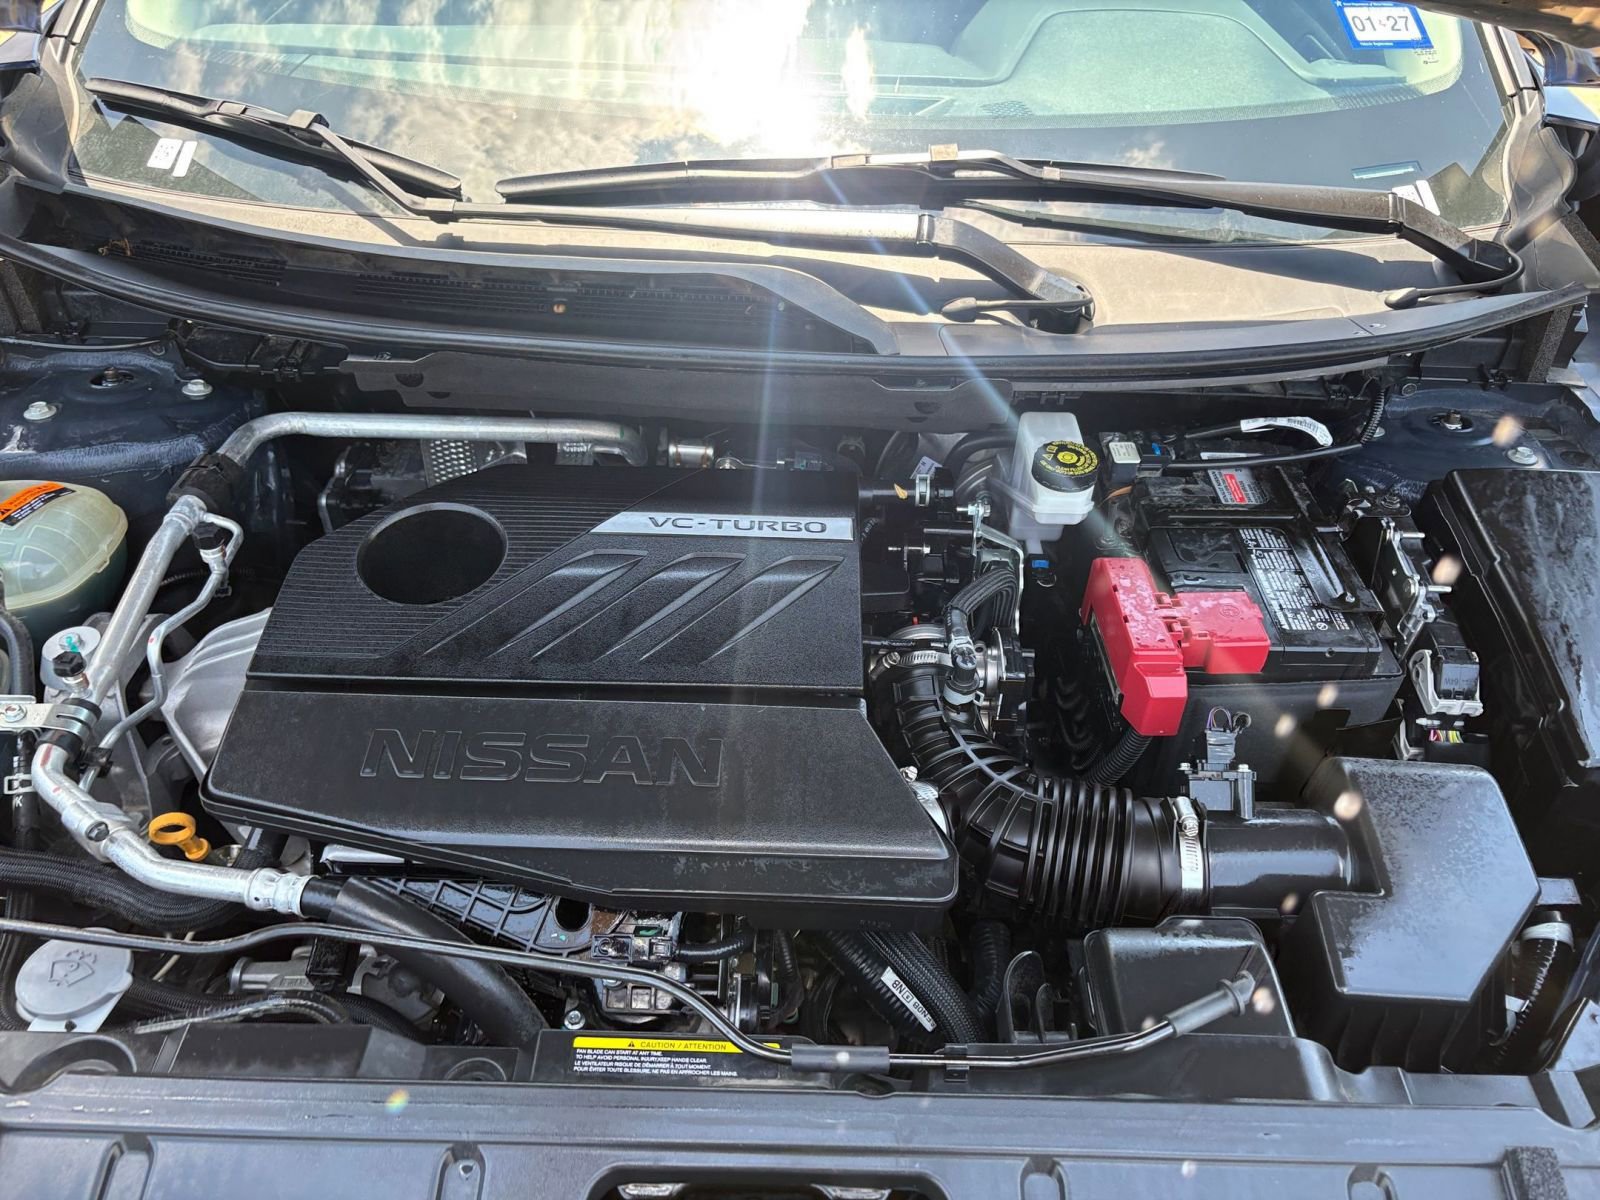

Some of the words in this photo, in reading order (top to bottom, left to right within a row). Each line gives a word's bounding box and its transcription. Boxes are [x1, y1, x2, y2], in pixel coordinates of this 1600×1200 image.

[1352, 16, 1377, 32] 01
[1386, 16, 1409, 32] 27
[648, 516, 828, 534] VC-TURBO
[360, 728, 724, 788] NISSAN
[640, 1041, 675, 1049] CAUTION
